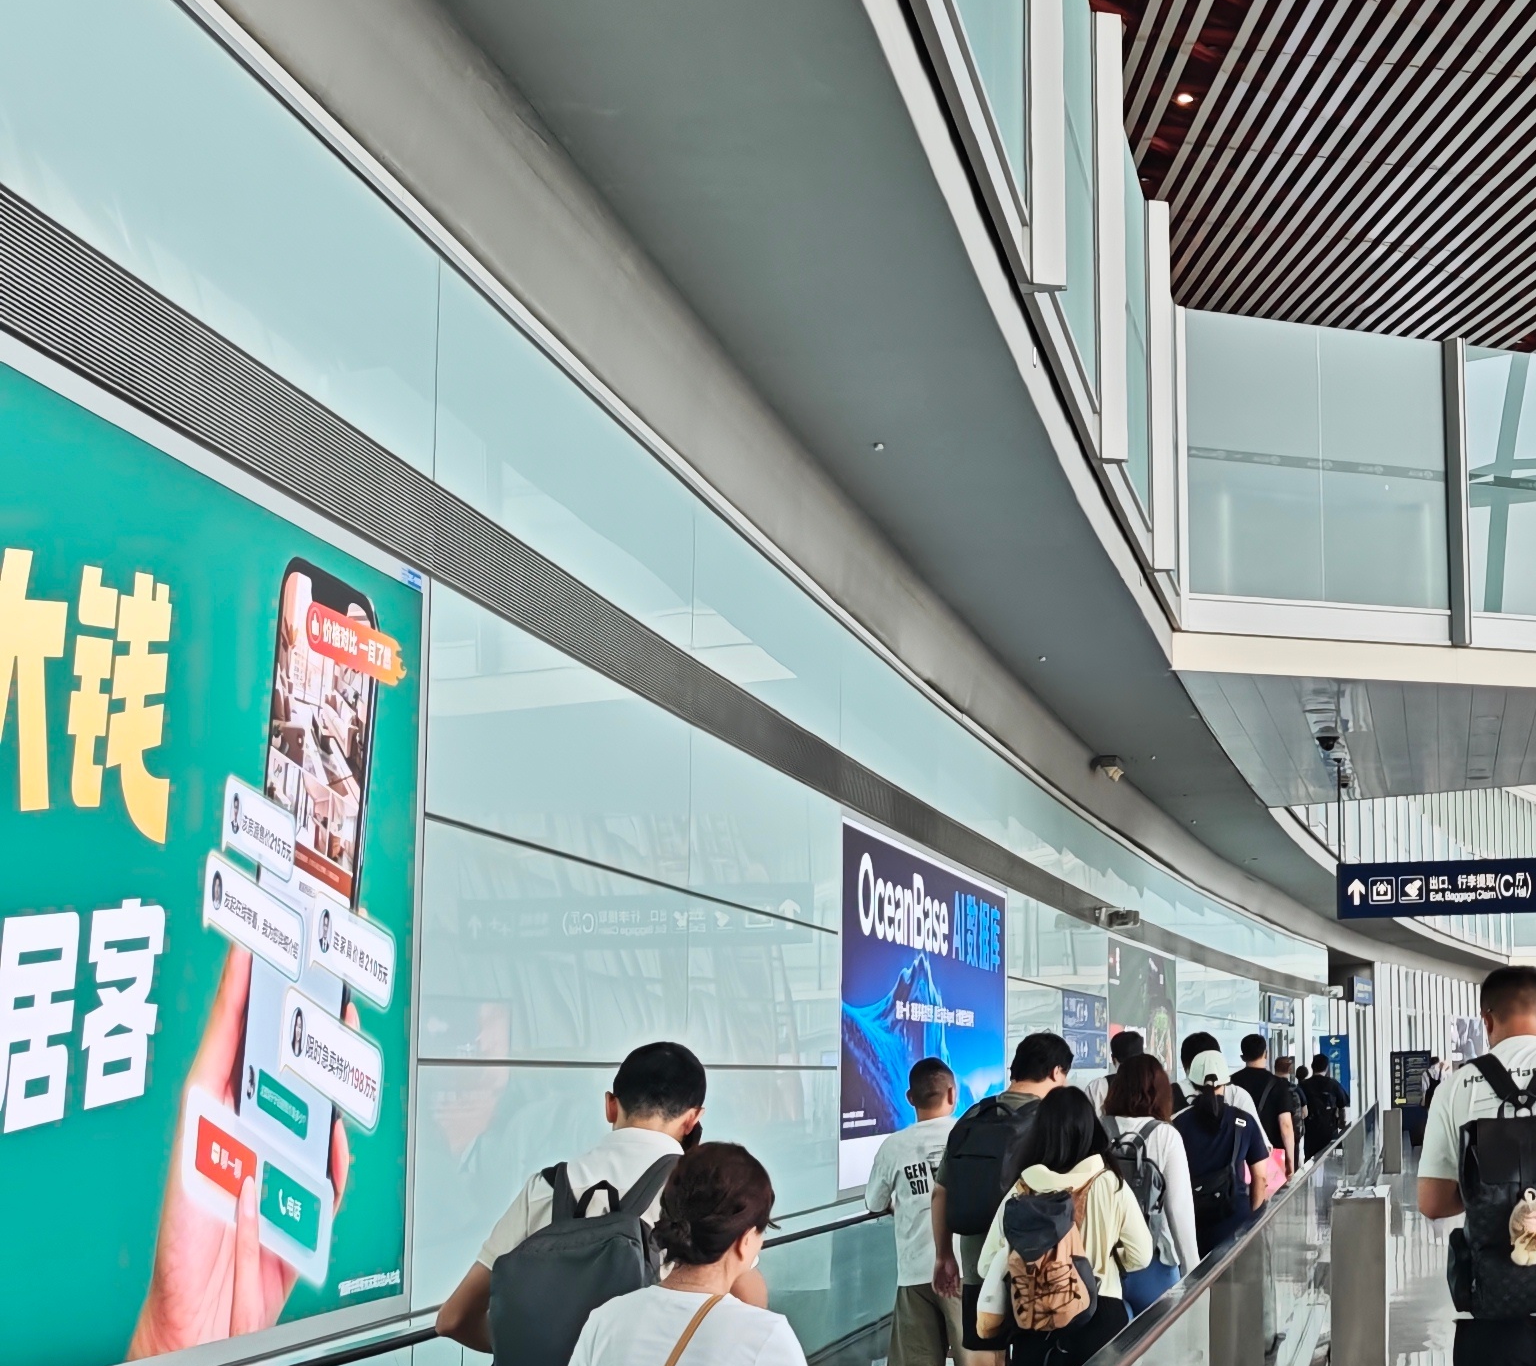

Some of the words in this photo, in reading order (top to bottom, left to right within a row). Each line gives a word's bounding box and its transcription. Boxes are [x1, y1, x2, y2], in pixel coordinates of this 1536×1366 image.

[858, 852, 950, 957] OceanBase
[1476, 889, 1496, 900] Claim
[0, 897, 166, 1135] 居客
[904, 1161, 928, 1181] GEN
